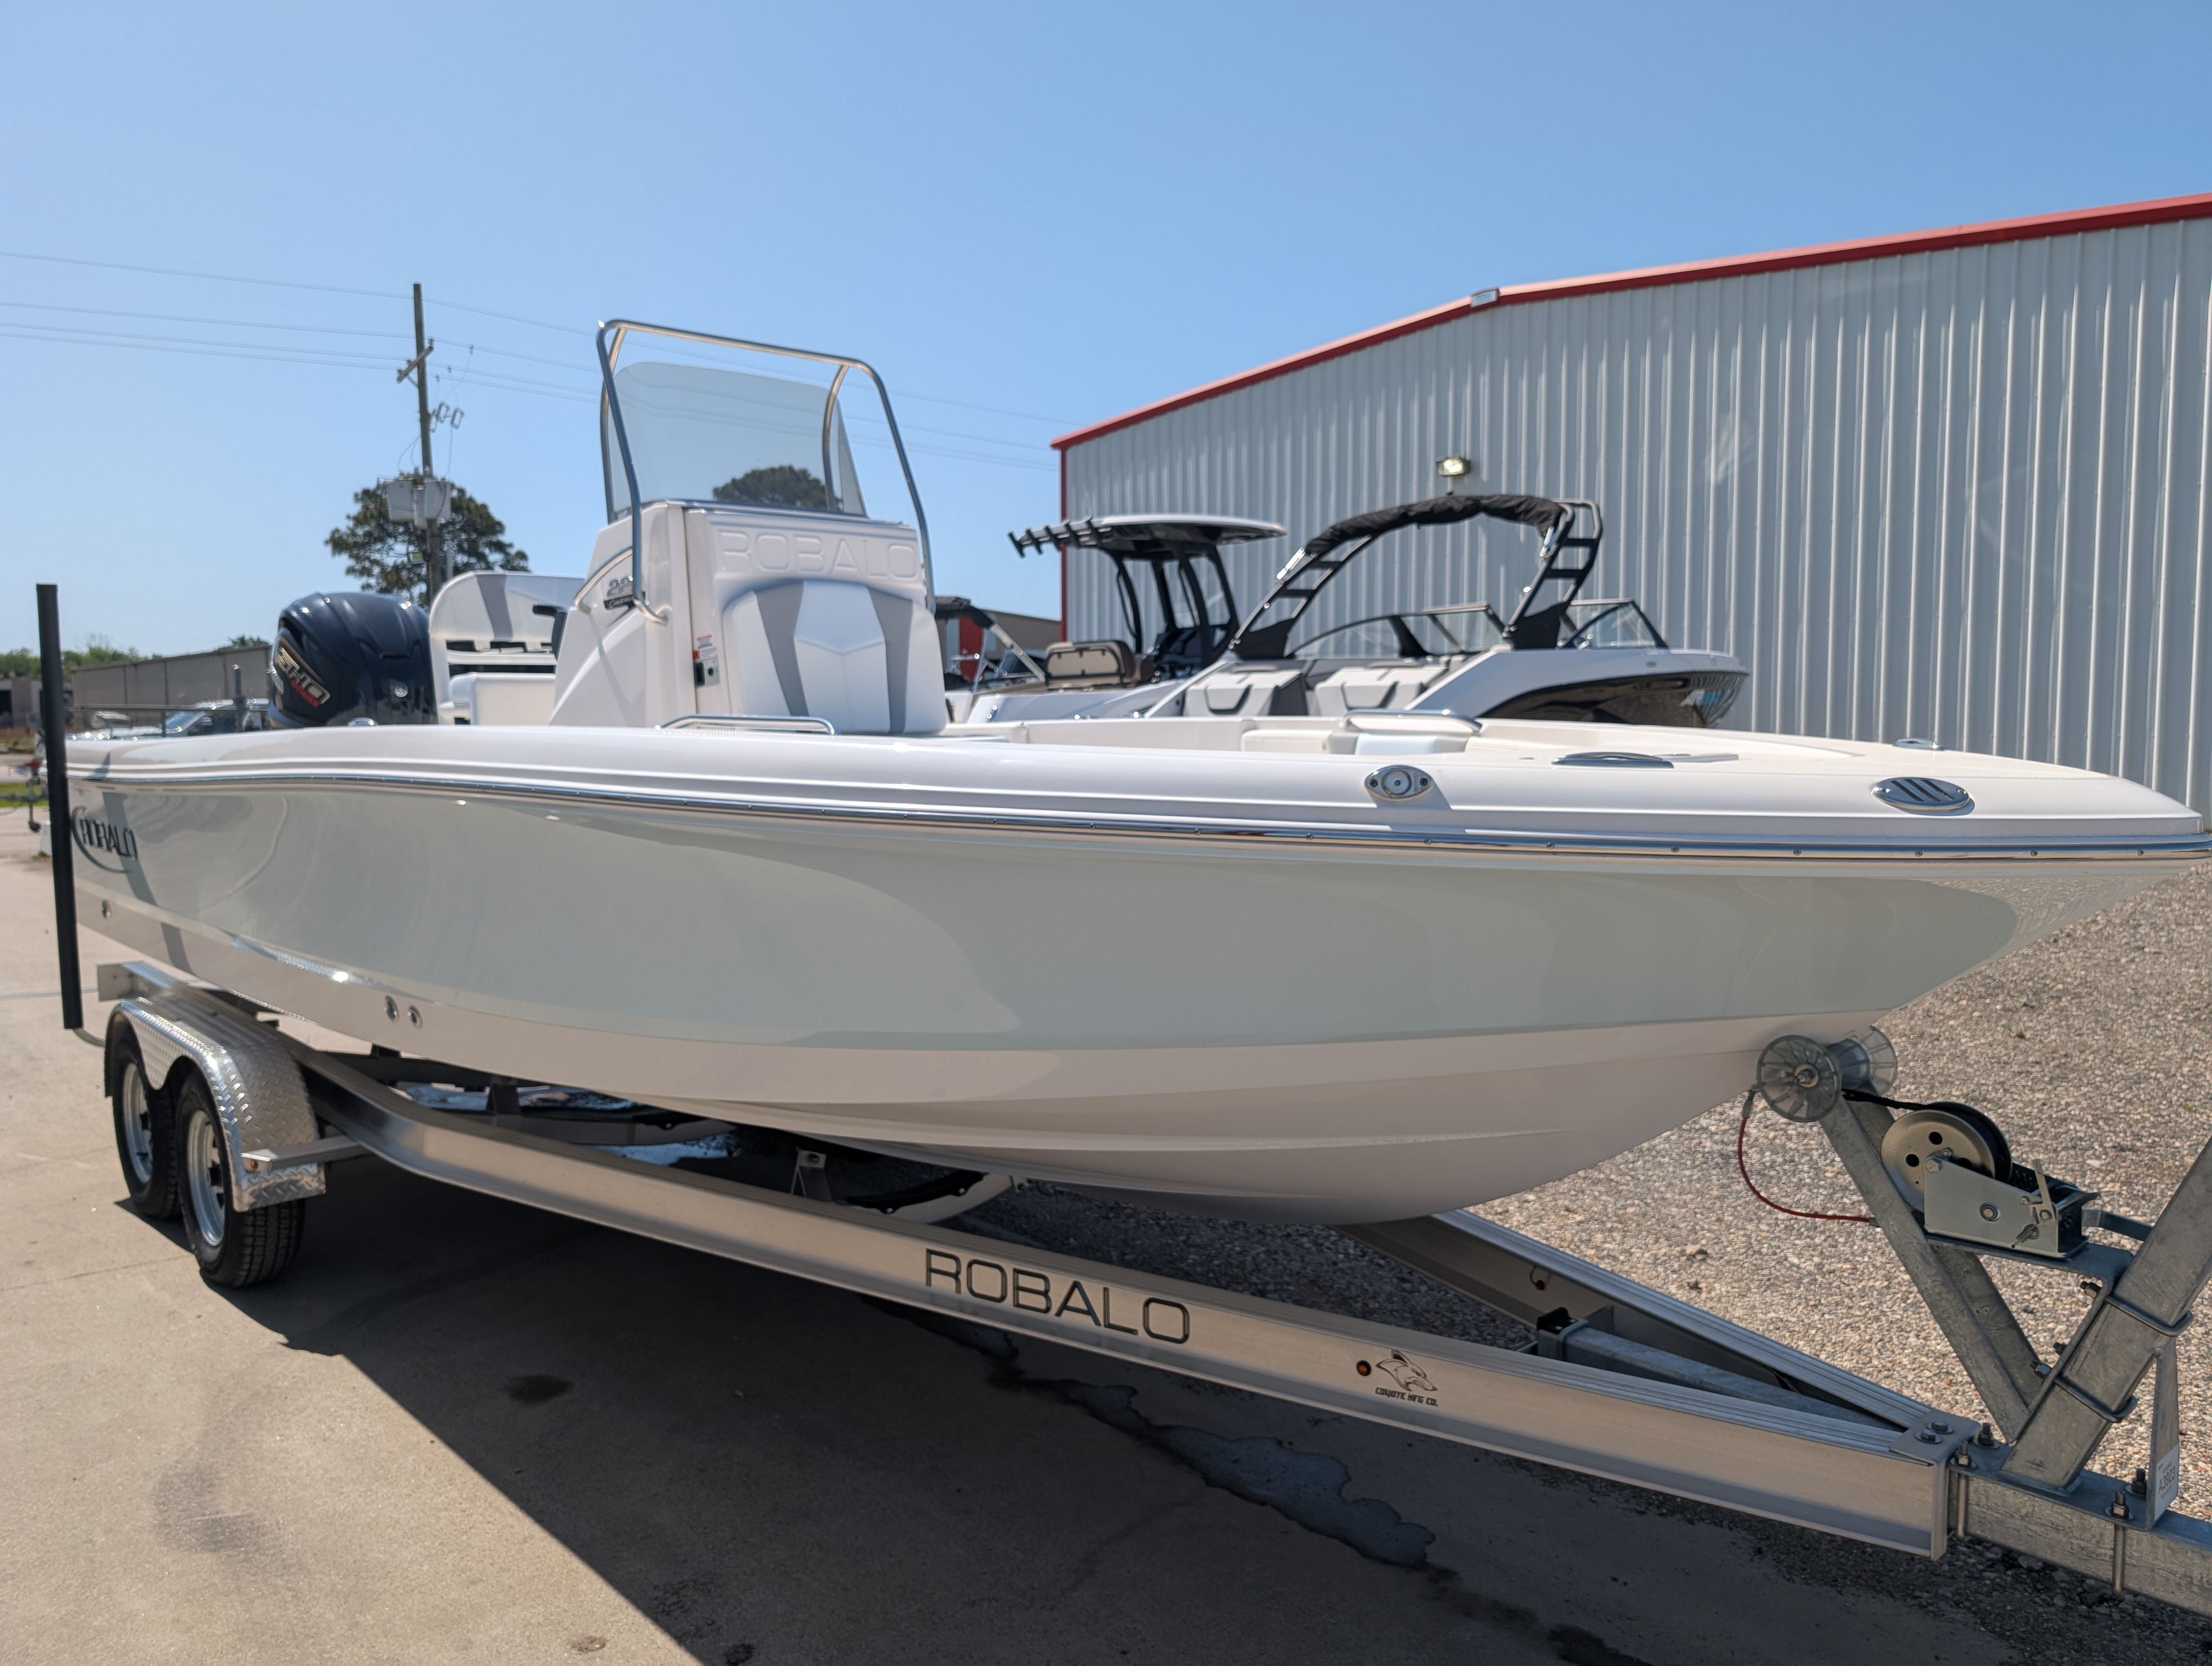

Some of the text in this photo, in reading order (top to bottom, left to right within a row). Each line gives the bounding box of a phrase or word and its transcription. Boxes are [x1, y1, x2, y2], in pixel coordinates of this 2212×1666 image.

[718, 529, 917, 580] ROBALO
[925, 1248, 1191, 1344] ROBALO
[1375, 1387, 1406, 1400] COYOTE
[1407, 1393, 1425, 1404] MFG
